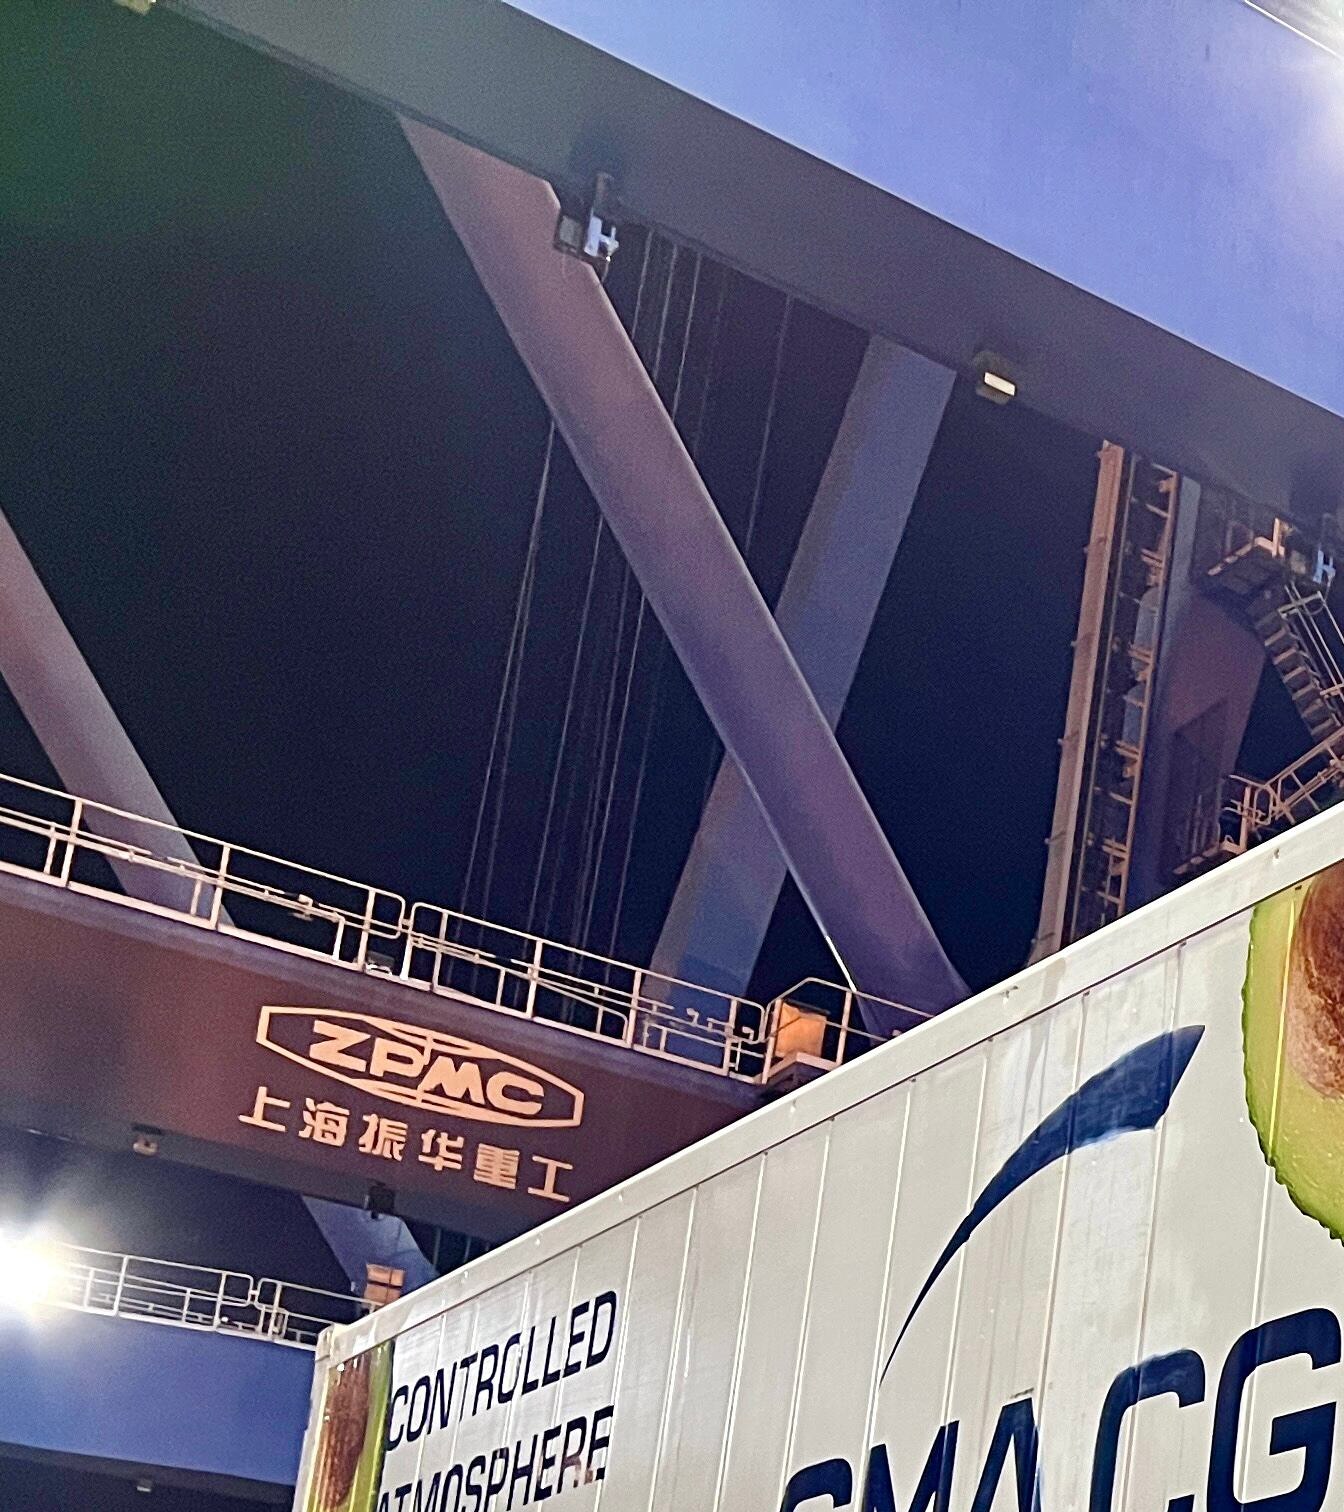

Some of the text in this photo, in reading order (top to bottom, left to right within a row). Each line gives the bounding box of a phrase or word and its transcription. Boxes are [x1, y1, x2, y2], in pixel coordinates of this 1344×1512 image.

[308, 1019, 545, 1116] ZPMC
[238, 1085, 575, 1203] 上海振华重工
[385, 1289, 617, 1453] CONTROLLED
